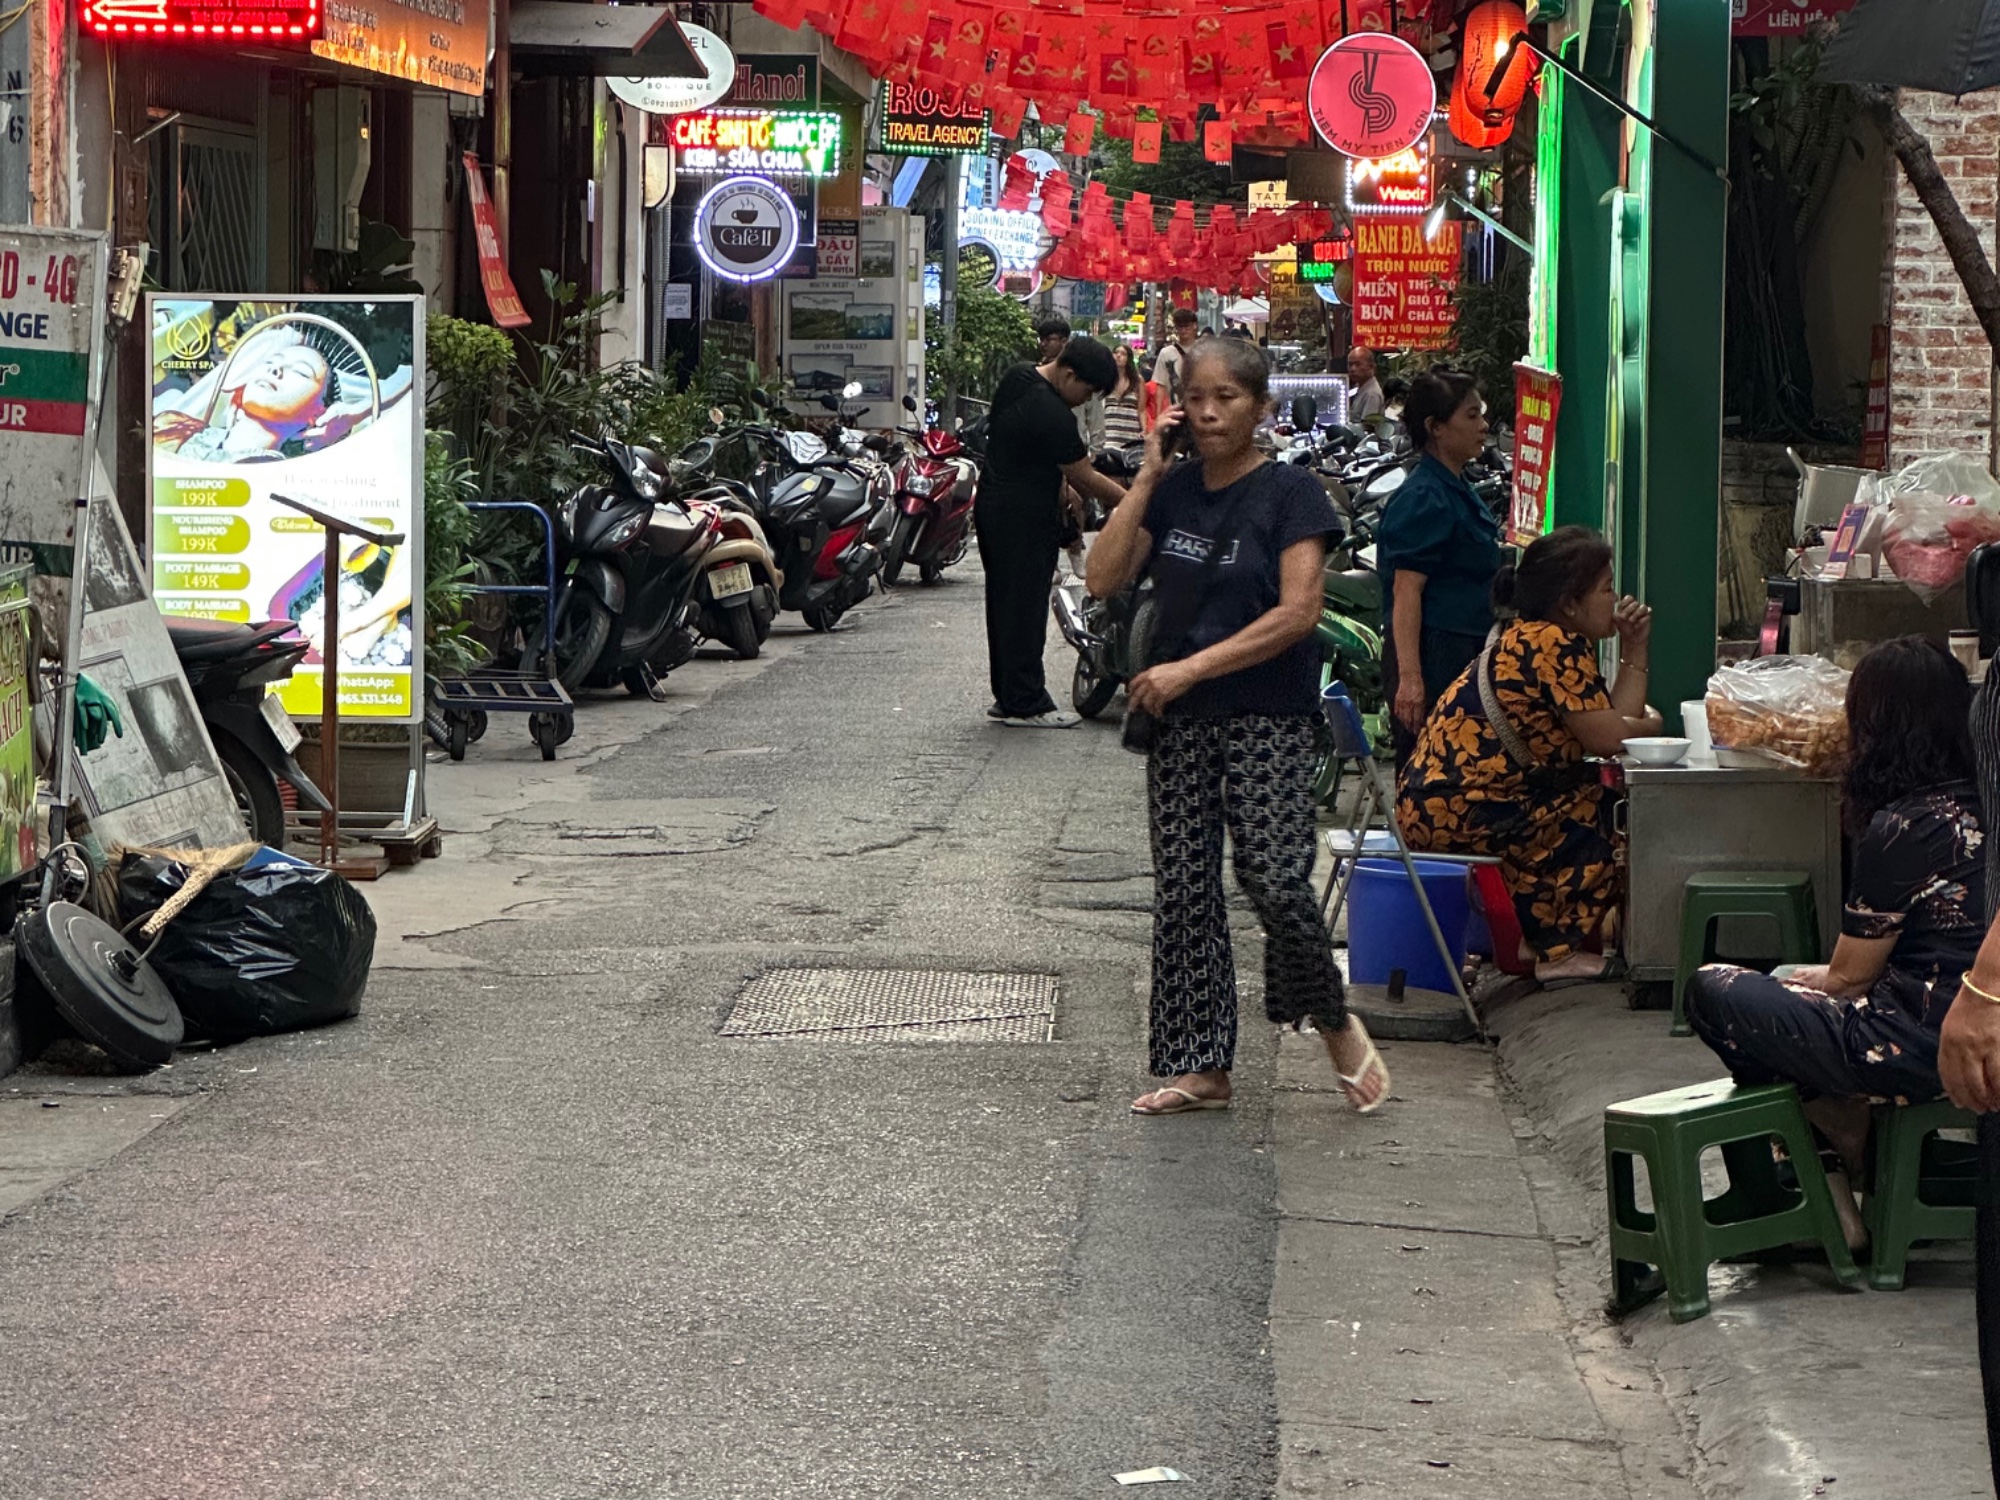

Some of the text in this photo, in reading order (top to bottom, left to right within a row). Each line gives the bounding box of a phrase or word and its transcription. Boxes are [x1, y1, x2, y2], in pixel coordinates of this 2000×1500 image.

[1768, 9, 1800, 27] LIÊN
[733, 64, 807, 102] Hanoi
[9, 115, 24, 144] 6
[675, 115, 713, 146] CAFÉ
[888, 122, 982, 144] TRAVEL AGENCY
[761, 150, 804, 170] CHUA
[720, 228, 759, 246] Café
[1357, 218, 1399, 254] BÁNH
[1402, 225, 1423, 254] ĐA
[1365, 257, 1450, 276] TRỘN NƯỚC
[44, 254, 77, 304] 4G
[1360, 300, 1395, 320] BÚN
[161, 360, 215, 370] CHERRY SPA
[175, 479, 226, 490] SHAMPOO
[181, 492, 218, 506] 199K
[181, 537, 218, 551] 199K
[165, 563, 193, 574] FOOT
[183, 575, 219, 588] 149K
[165, 600, 193, 610] BODY
[339, 676, 395, 689] hatsApp:
